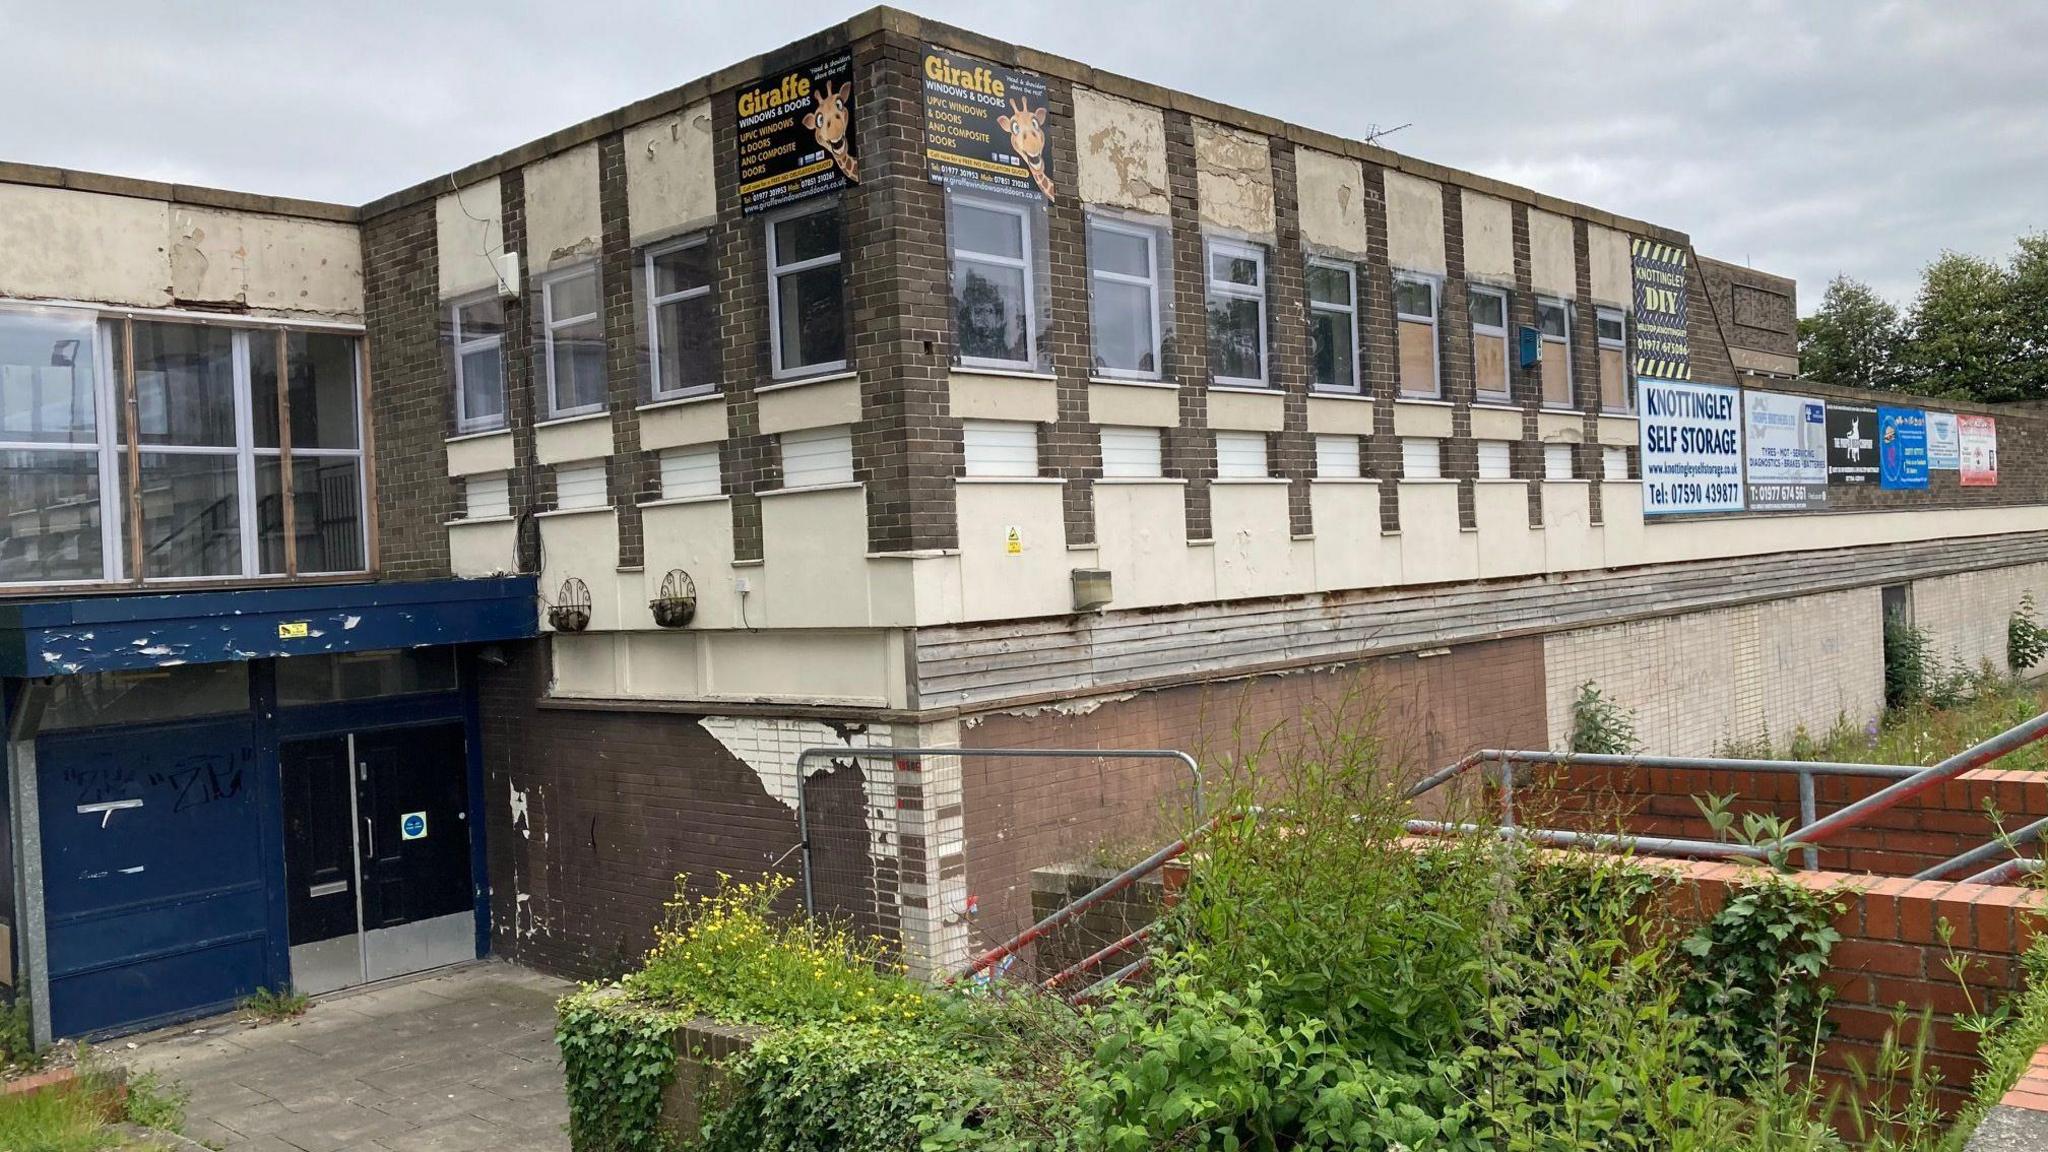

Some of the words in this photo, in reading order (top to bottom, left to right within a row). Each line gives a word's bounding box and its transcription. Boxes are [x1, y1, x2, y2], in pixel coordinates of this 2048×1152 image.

[925, 55, 1005, 97] Giraffe
[738, 73, 811, 117] Giraffe
[926, 80, 968, 100] WINDOWS
[969, 92, 976, 100] &
[977, 94, 1006, 108] DOORS
[738, 109, 776, 129] WINDOWS
[777, 105, 783, 115] &
[784, 96, 811, 112] DOORS
[926, 96, 948, 108] UPVC
[948, 100, 988, 118] WINDOWS
[928, 108, 934, 118] &
[935, 111, 962, 125] DOORS
[740, 130, 758, 143] UPVC
[759, 118, 794, 136] WINDOWS
[928, 121, 946, 133] AND
[948, 125, 990, 144] COMPOSITE
[929, 134, 957, 148] DOORS
[740, 145, 746, 154] &
[747, 138, 771, 152] DOORS
[741, 154, 757, 167] AND
[758, 142, 797, 162] COMPOSITE
[742, 164, 766, 179] DOORS
[941, 165, 958, 174] 01977
[752, 192, 768, 202] 01977
[1636, 266, 1685, 287] KNOTTINGLEY
[1644, 286, 1678, 315] DIY
[1638, 338, 1660, 351] 01977
[1647, 388, 1734, 420] KNOTTINGLEY
[1648, 424, 1677, 453] SELF
[1681, 426, 1737, 455] STORAGE
[1762, 448, 1776, 456] TYRES
[1780, 448, 1790, 456] MOT
[1649, 461, 1738, 478] www.knottingleyselfstorage.co.uk
[1750, 458, 1780, 468] DIAGNOSTICS
[1784, 459, 1800, 468] BRAKES
[1650, 484, 1668, 505] Tel:
[1672, 484, 1701, 504] 07590
[1705, 484, 1738, 504] 439877
[1750, 486, 1758, 500] T:
[1759, 486, 1780, 500] 01977
[1782, 486, 1794, 500] 674
